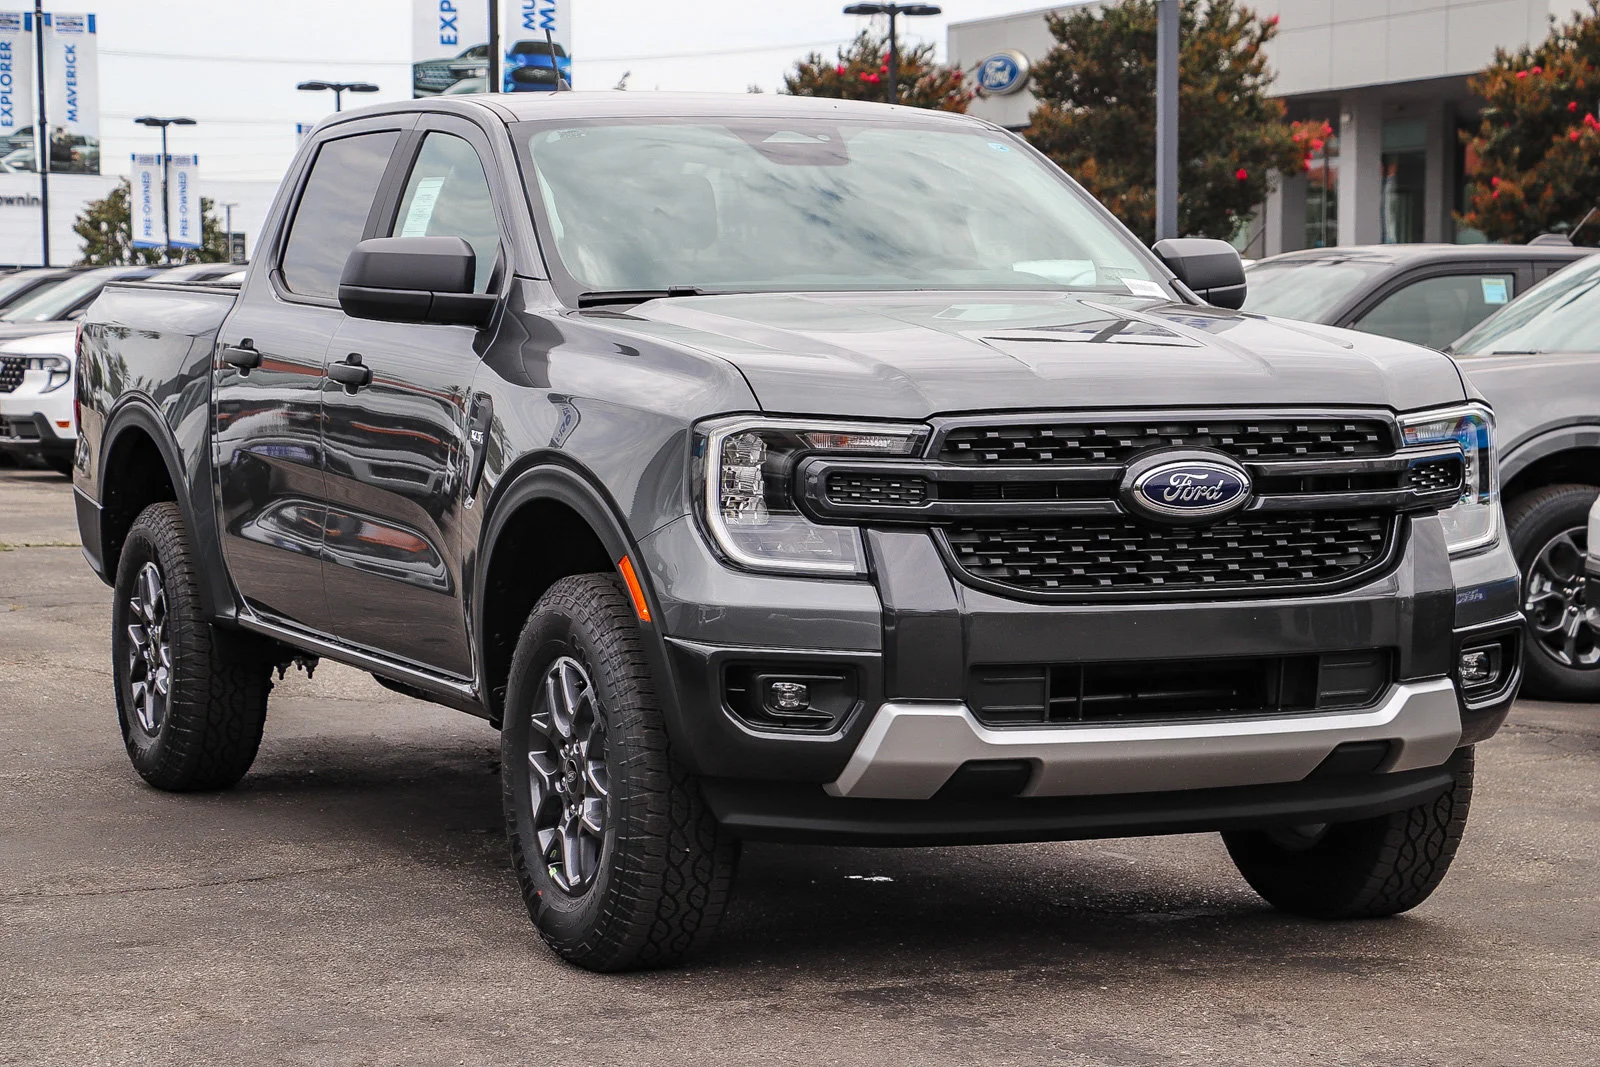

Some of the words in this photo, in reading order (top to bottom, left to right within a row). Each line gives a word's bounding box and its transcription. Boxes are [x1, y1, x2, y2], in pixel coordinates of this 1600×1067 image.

[0, 41, 13, 127] EXPLORER
[64, 44, 79, 123] MAVERICK
[982, 60, 1011, 87] Ford
[1163, 473, 1224, 502] Ford
